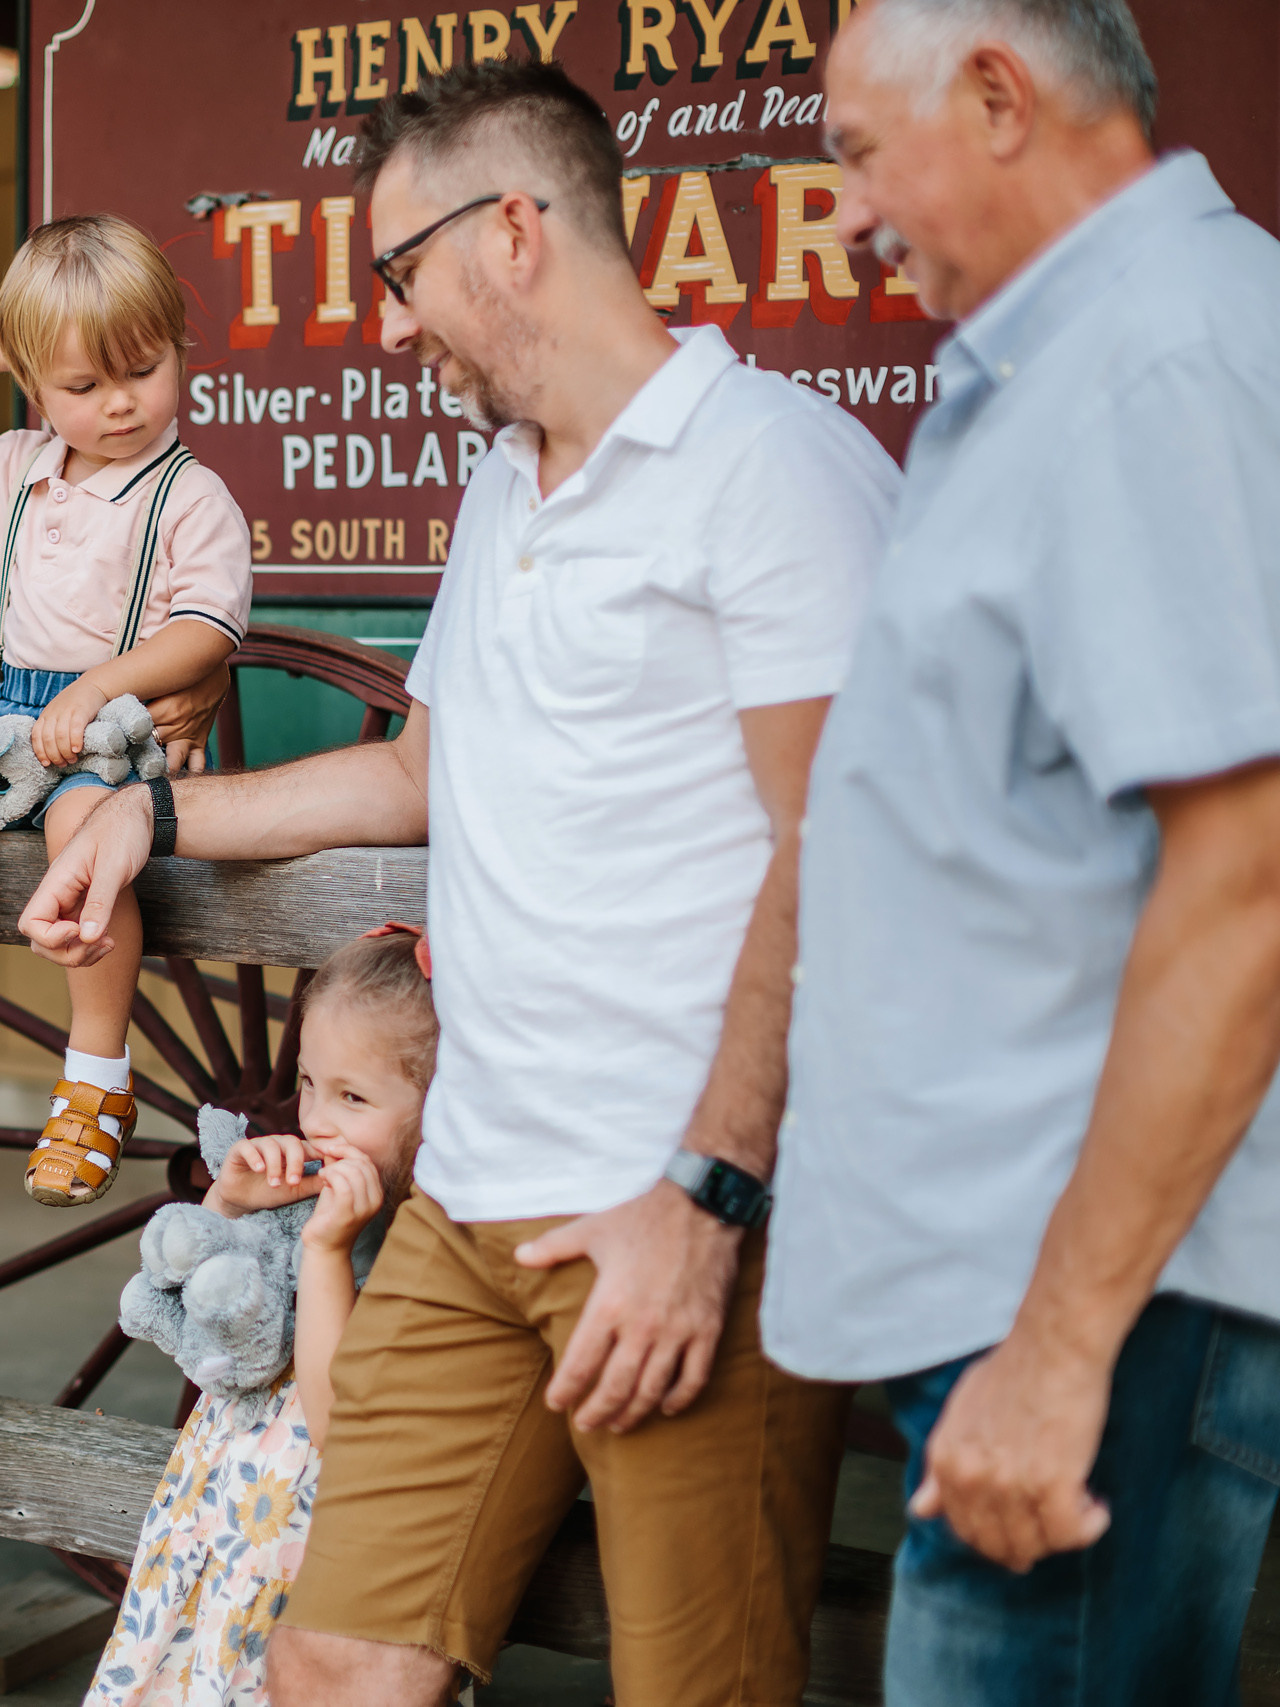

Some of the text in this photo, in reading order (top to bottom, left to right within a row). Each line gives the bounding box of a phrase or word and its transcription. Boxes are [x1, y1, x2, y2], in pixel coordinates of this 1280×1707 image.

[295, 0, 858, 107] HENRY RYA
[615, 97, 660, 158] of
[667, 88, 746, 137] and
[759, 85, 829, 130] Dea
[282, 430, 498, 489] PEDLAR
[290, 518, 406, 561] SOUTH
